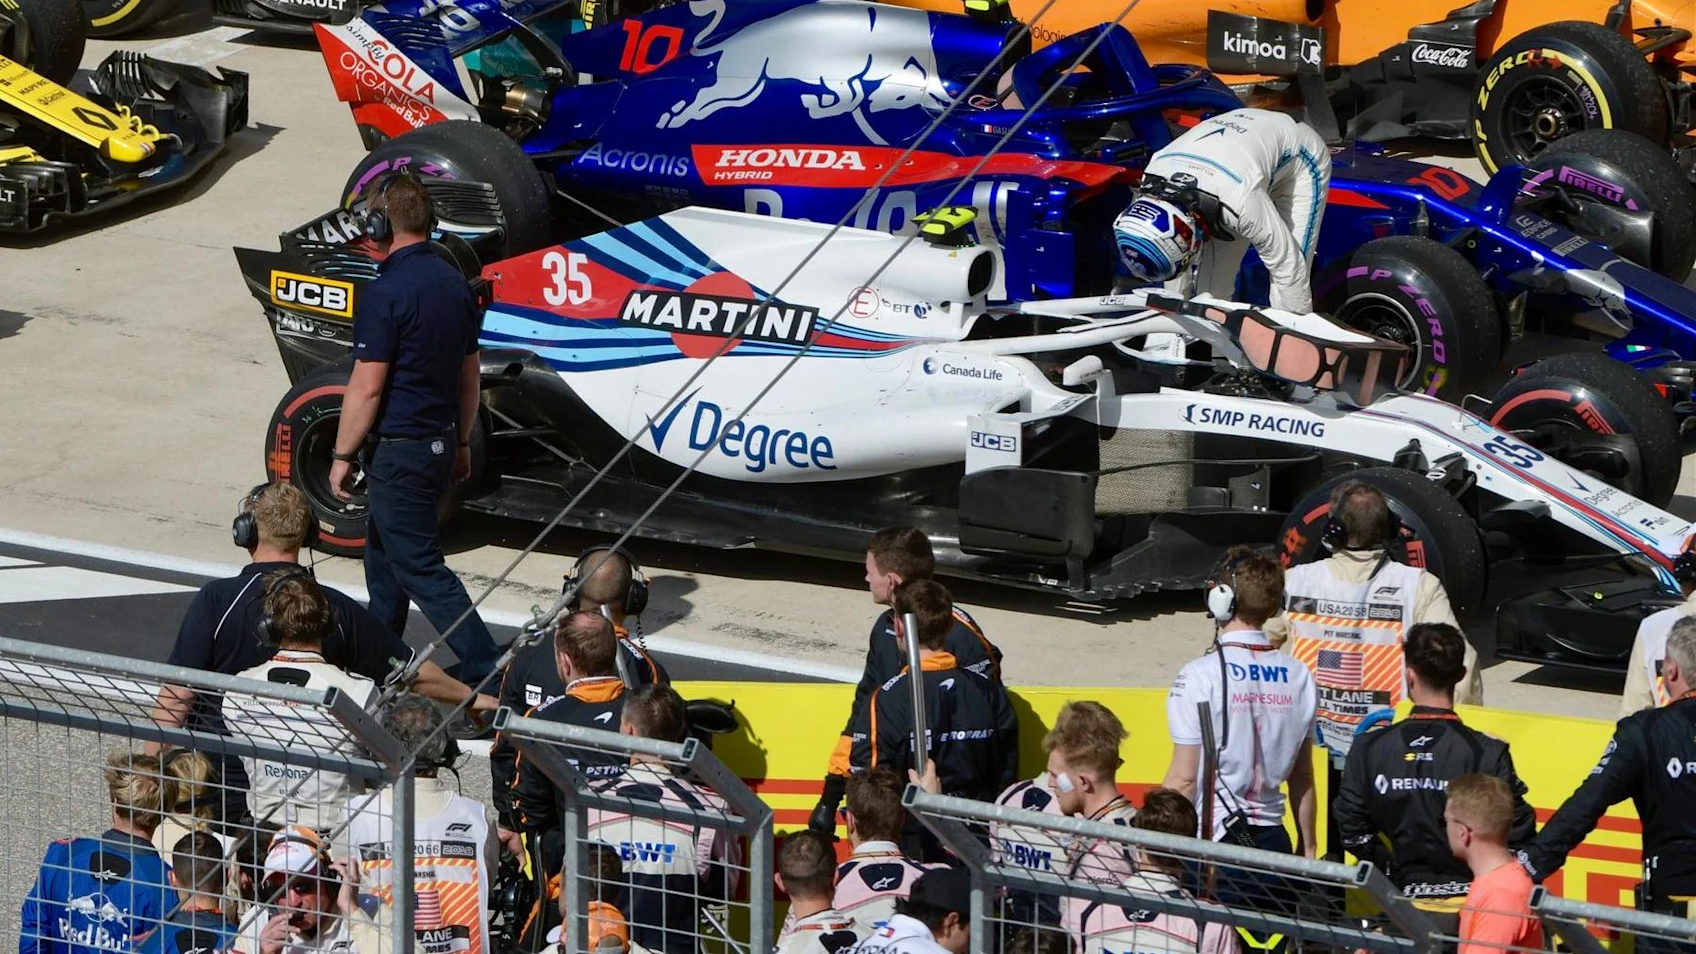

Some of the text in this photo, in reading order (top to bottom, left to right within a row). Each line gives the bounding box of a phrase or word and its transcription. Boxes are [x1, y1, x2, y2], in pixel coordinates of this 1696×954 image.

[346, 22, 386, 60] simply
[619, 18, 685, 75] 10
[1223, 31, 1286, 61] kimoa
[1412, 44, 1471, 68] Coca-Cola
[369, 39, 436, 104] COLA
[17, 78, 50, 96] MAPFRE
[340, 51, 432, 122] ORGANICS
[578, 144, 689, 177] Acronis
[714, 148, 866, 171] HONDA
[714, 171, 773, 180] HYBRID
[1558, 165, 1625, 203] PIRELLI
[1551, 235, 1591, 257] PIRELLI
[542, 250, 593, 306] 35
[277, 279, 347, 311] JCB
[622, 293, 813, 343] MARTINI
[892, 304, 912, 314] BT
[1397, 283, 1448, 365] ZERO
[942, 363, 1003, 381] Canada Life
[1199, 407, 1326, 438] SMP RACING
[689, 400, 839, 474] Degree
[974, 432, 1016, 452] JCB
[1483, 434, 1545, 470] 35
[1248, 665, 1289, 684] BWT
[1231, 692, 1293, 706] MAGNESIUM
[1332, 690, 1374, 704] LANE
[1332, 703, 1369, 715] TIMES
[264, 763, 308, 780] Rexona
[620, 842, 677, 863] BWT
[1015, 844, 1053, 870] BWT
[58, 917, 87, 944] Red
[415, 927, 453, 944] LANE
